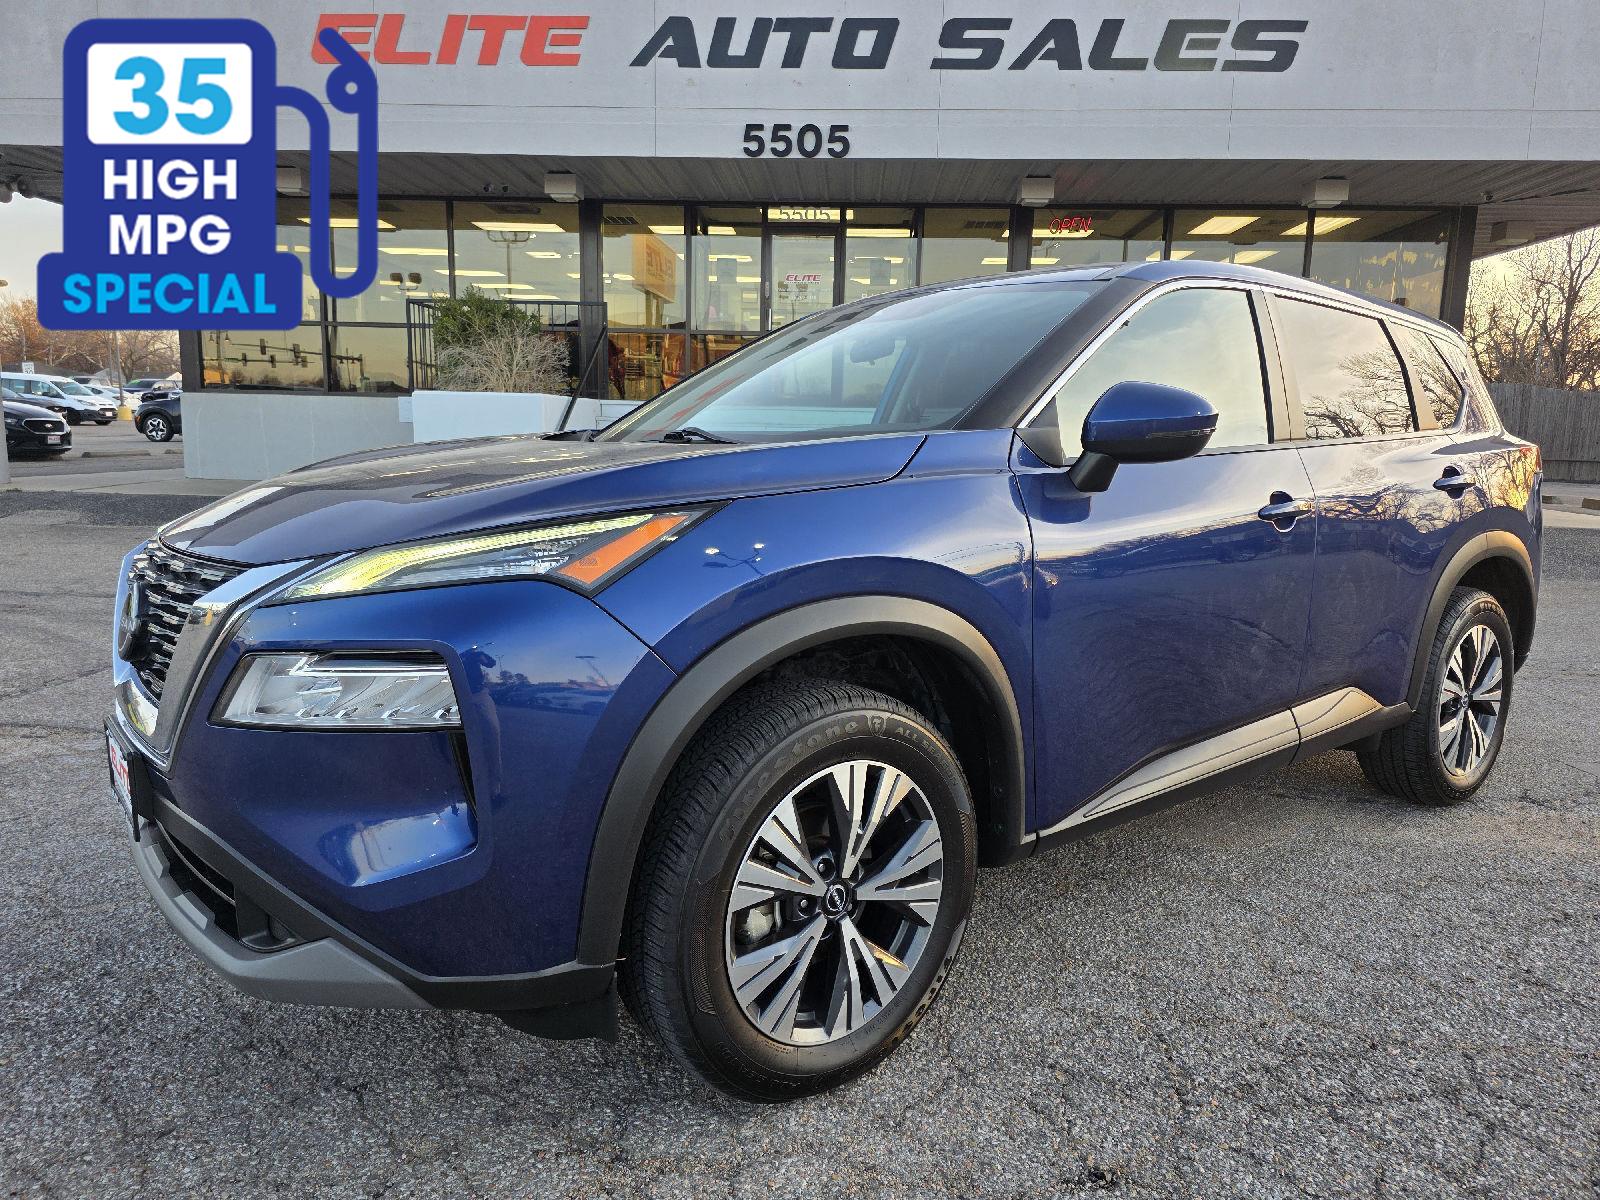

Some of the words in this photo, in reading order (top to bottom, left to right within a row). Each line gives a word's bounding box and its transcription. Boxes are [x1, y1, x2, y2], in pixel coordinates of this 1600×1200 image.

[311, 13, 590, 66] ELITE
[630, 16, 899, 70] AUTO
[929, 17, 1309, 72] SALES
[742, 123, 851, 158] 5505
[780, 206, 831, 222] 5505
[1049, 216, 1092, 234] OPEN
[785, 274, 822, 282] ELITE
